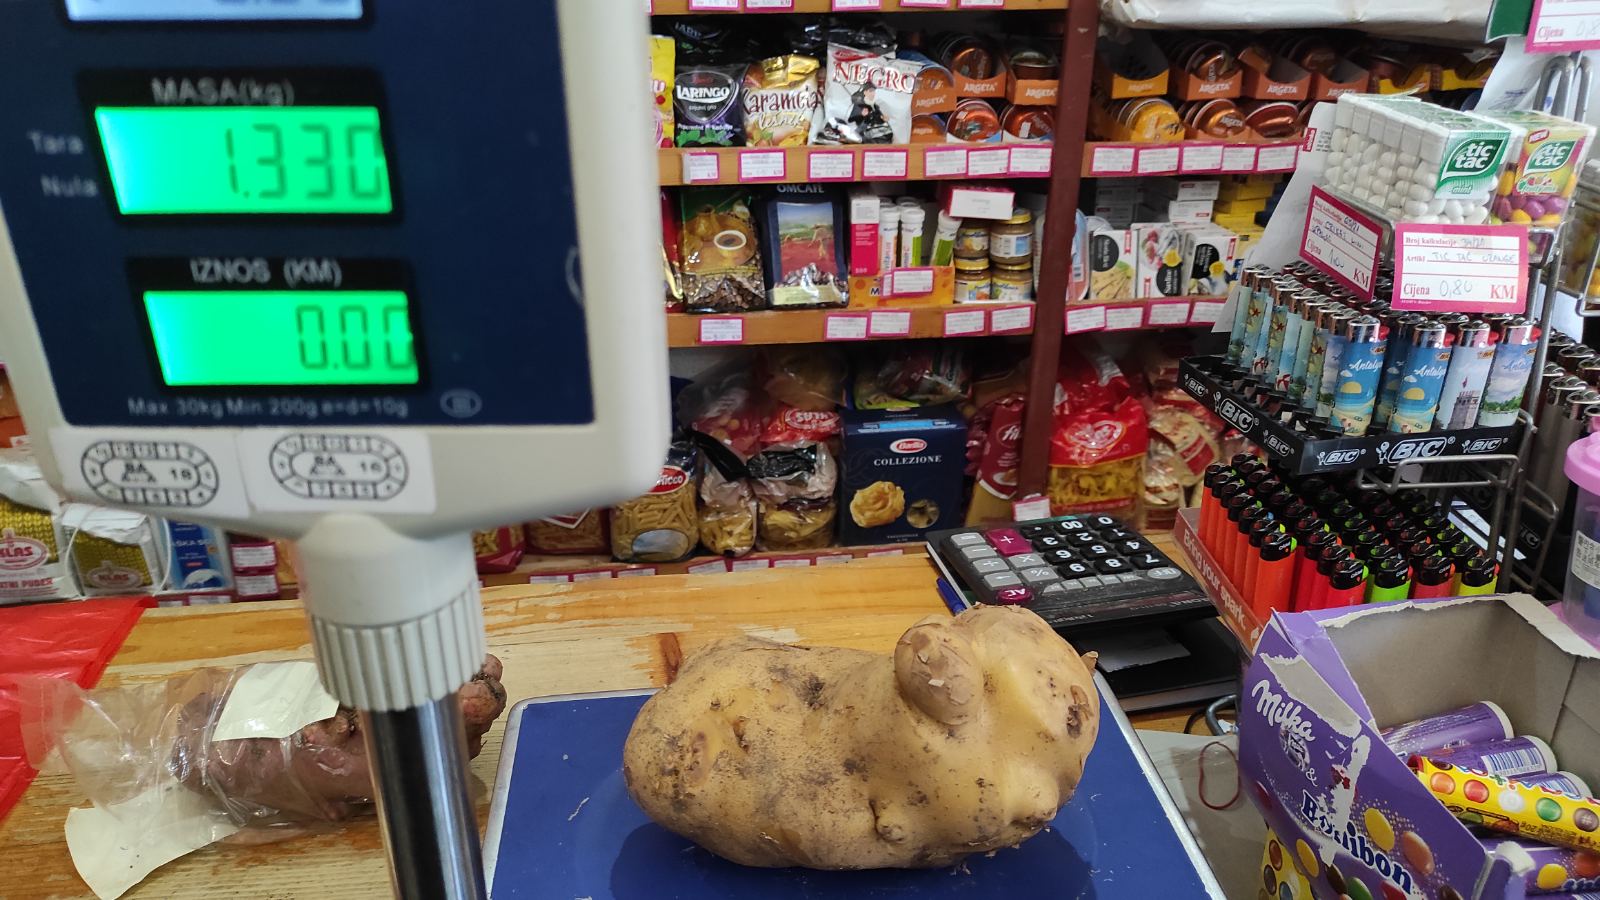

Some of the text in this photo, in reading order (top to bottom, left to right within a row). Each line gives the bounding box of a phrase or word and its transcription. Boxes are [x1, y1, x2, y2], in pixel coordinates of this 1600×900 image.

[832, 61, 916, 94] NEGRO
[152, 78, 294, 107] MASA(kg)
[676, 85, 730, 103] LARINGO
[964, 83, 996, 94] ARGETA
[1026, 88, 1057, 98] ARGETA
[1199, 82, 1231, 94] ARGETA
[1267, 83, 1298, 95] ARGETA
[27, 129, 84, 155] Tara
[1466, 141, 1491, 157] tic
[1543, 142, 1570, 157] tic
[224, 124, 384, 200] 1.330
[1455, 154, 1488, 169] tac
[1534, 154, 1563, 167] tac
[40, 173, 98, 197] Nula
[1451, 184, 1473, 194] mint
[190, 259, 343, 288] IZNOS (KM)
[1353, 268, 1370, 288] KM
[1403, 282, 1430, 297] Cijena
[1490, 285, 1515, 299] KM
[295, 305, 415, 371] 0.00
[1188, 380, 1205, 395] BIC
[127, 397, 168, 415] Max
[176, 397, 224, 418] 30kg
[226, 396, 264, 415] Min
[269, 396, 319, 418] 200g
[1221, 401, 1253, 429] BIC
[1268, 436, 1289, 454] BIC
[1391, 440, 1445, 460] BIC
[1470, 439, 1497, 451] BIC
[873, 455, 942, 466] COLLEZIONE
[1326, 451, 1356, 463] BIC
[1061, 516, 1113, 530] 0 00
[1042, 537, 1059, 546] 3
[1076, 532, 1093, 541] 2
[1055, 541, 1141, 559] 4 5 6
[1105, 558, 1123, 568] 8
[1144, 554, 1160, 564] 7
[1069, 563, 1086, 572] 9
[1183, 528, 1247, 630] Bring your spark.
[1251, 679, 1316, 741] Milka
